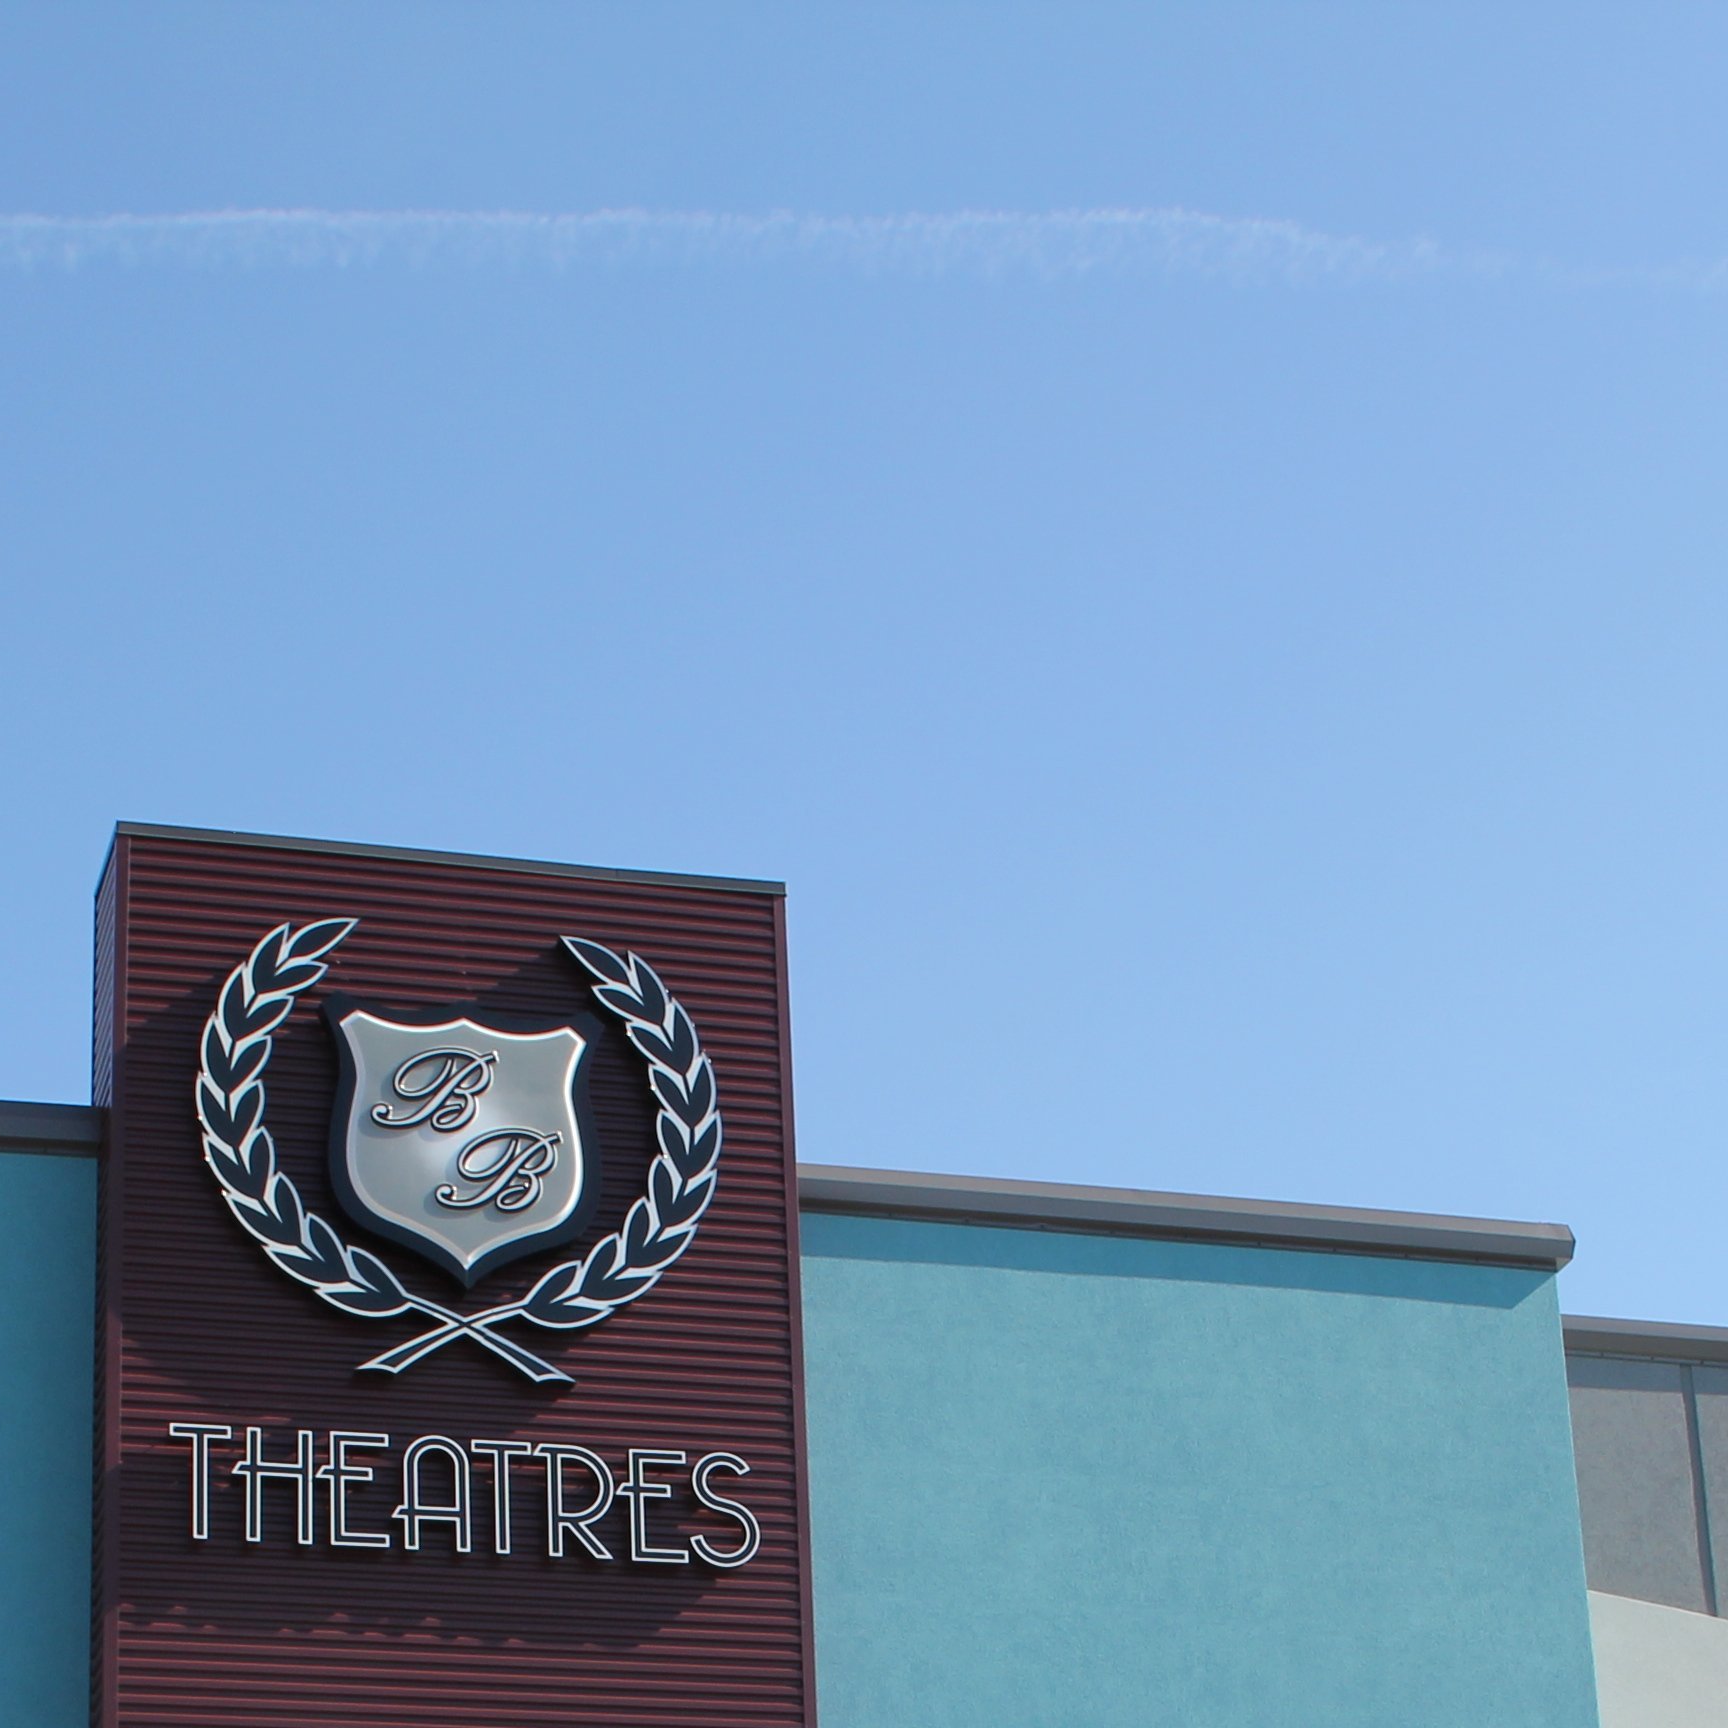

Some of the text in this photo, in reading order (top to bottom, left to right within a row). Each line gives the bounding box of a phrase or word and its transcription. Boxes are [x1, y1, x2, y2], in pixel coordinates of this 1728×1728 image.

[372, 1047, 500, 1131] B
[435, 1128, 564, 1211] B
[170, 1423, 761, 1567] THEATRES
